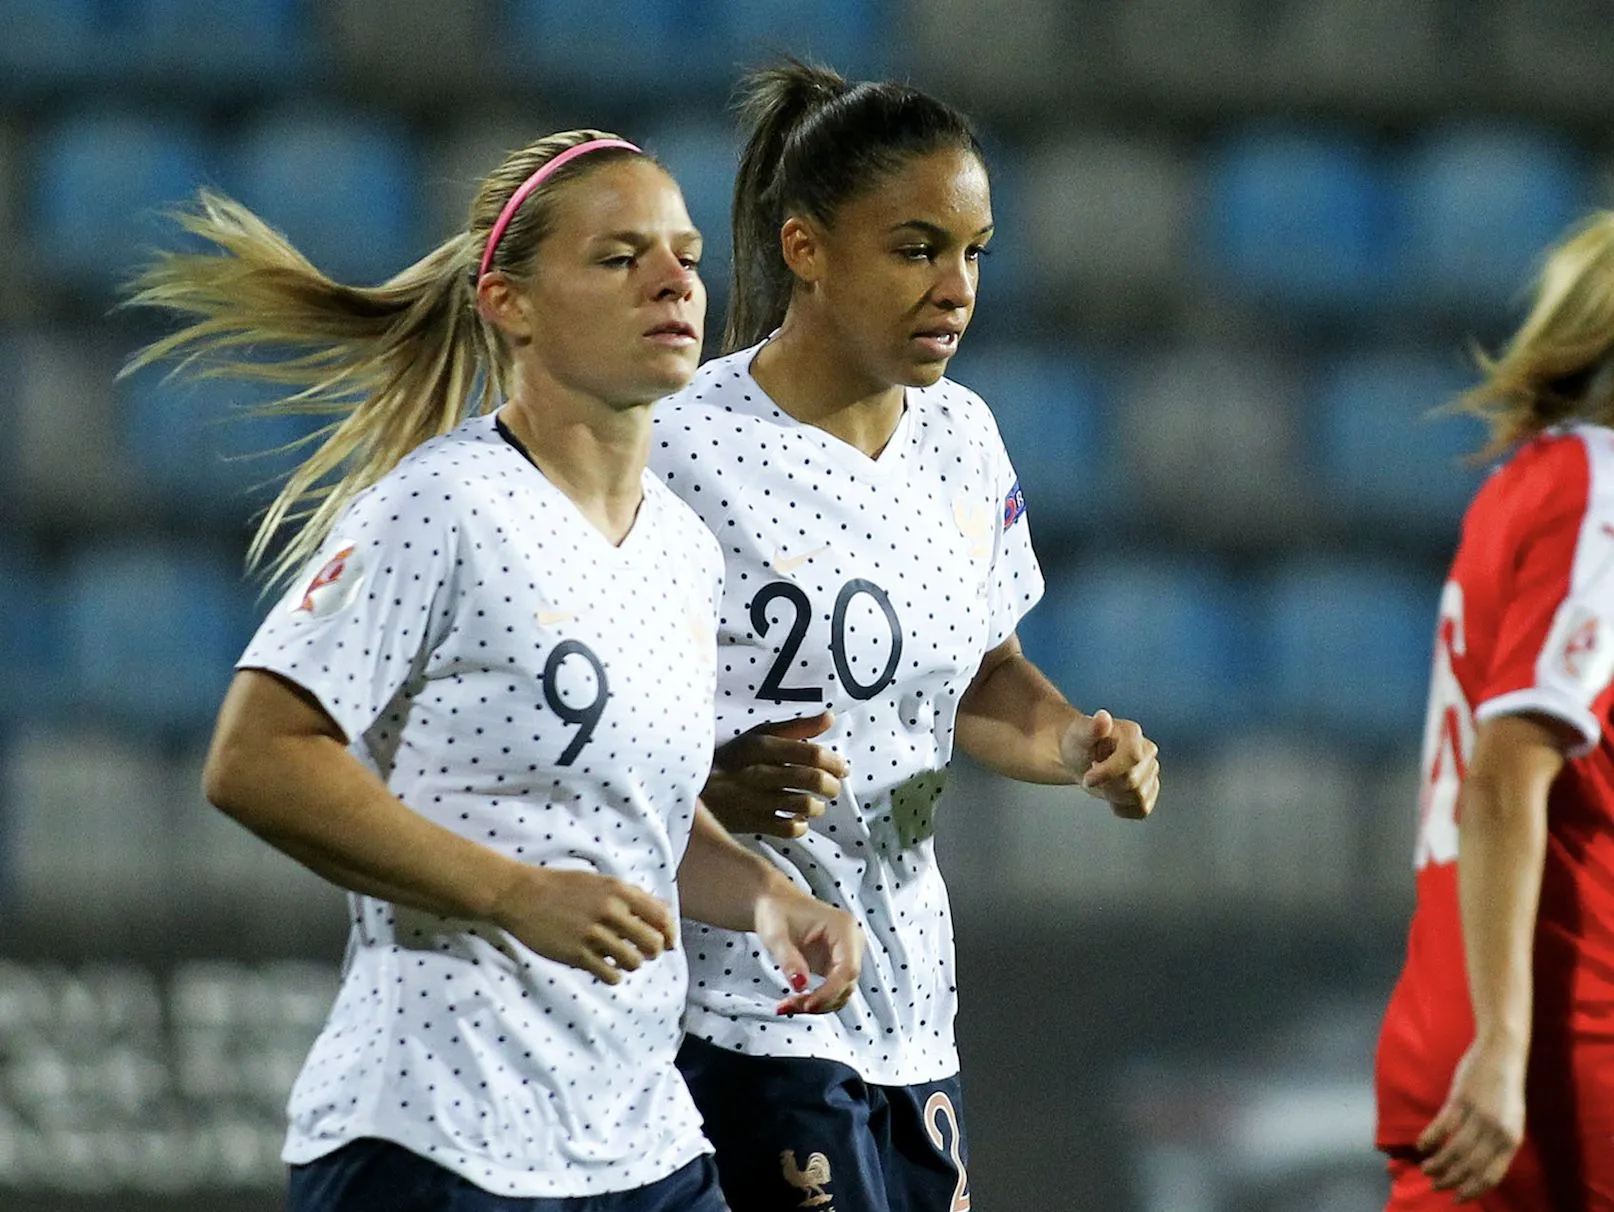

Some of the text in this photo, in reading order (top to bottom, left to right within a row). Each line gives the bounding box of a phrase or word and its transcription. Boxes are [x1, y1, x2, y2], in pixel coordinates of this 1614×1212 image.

[750, 578, 903, 702] 20
[543, 639, 609, 766] 9
[924, 1091, 971, 1212] 2
